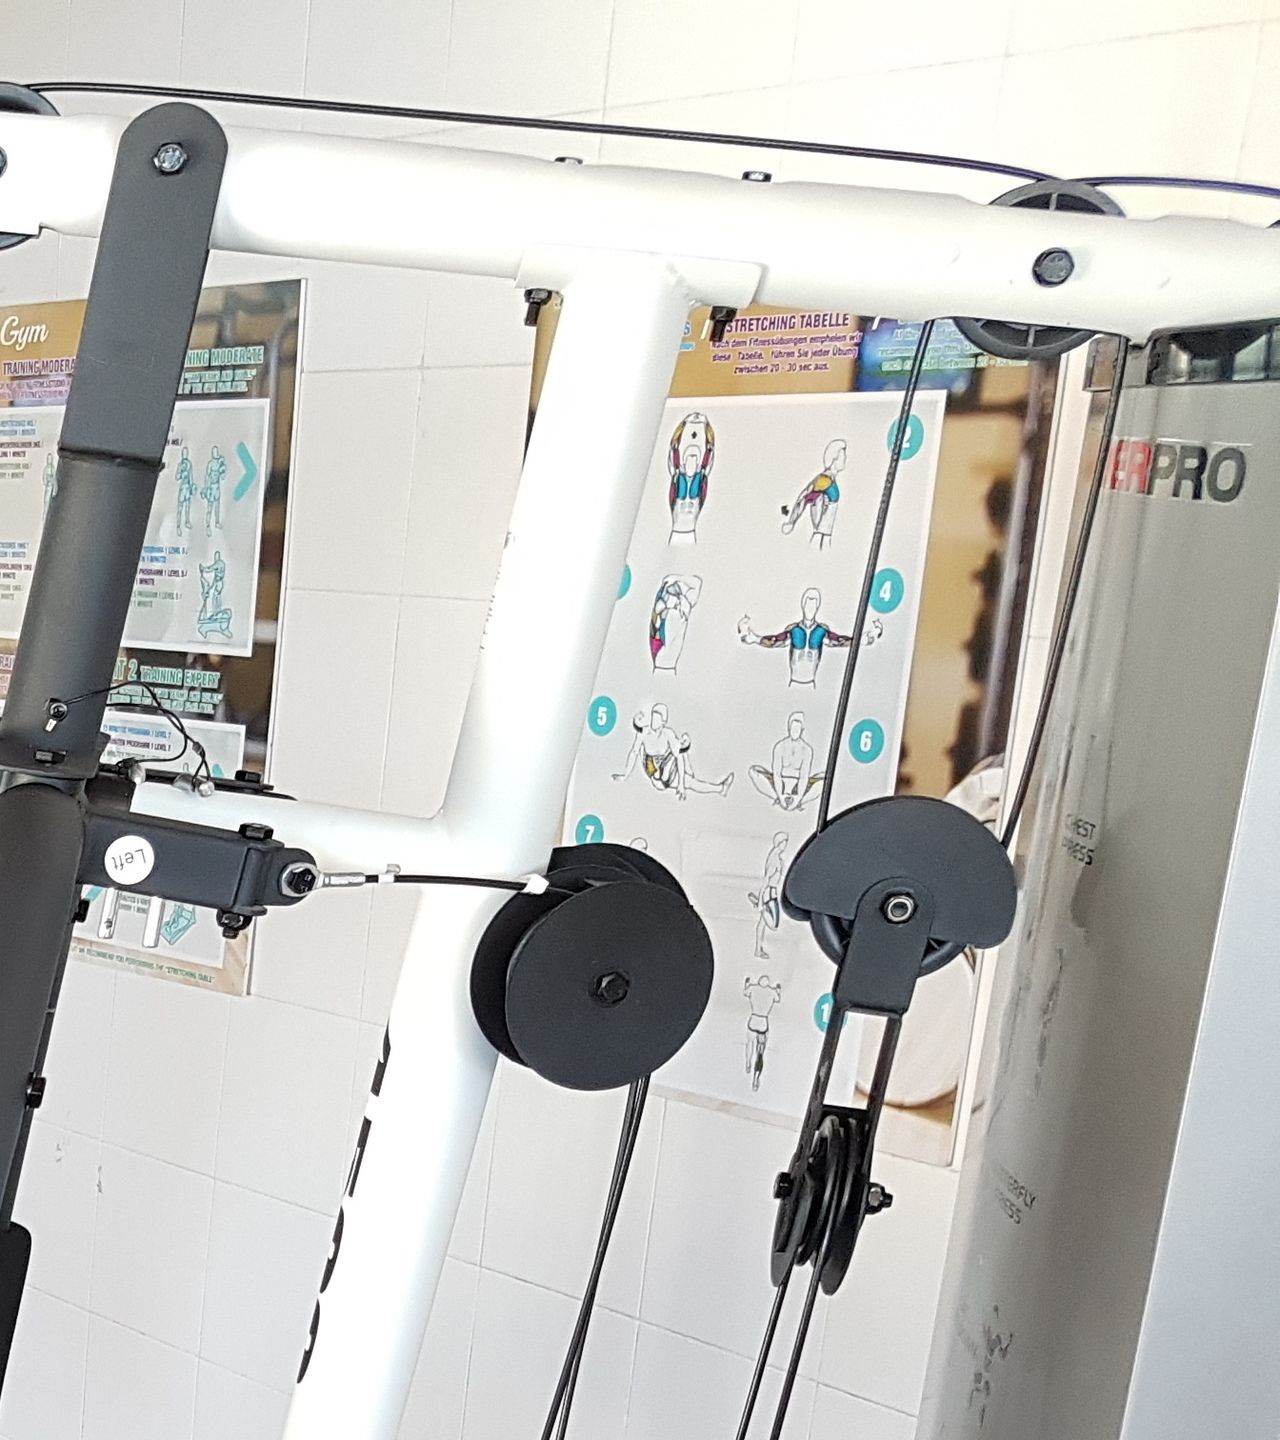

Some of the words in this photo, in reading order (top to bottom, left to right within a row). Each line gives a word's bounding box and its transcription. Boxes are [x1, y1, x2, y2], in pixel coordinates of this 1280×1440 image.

[0, 315, 48, 351] Gym
[726, 314, 796, 333] STRETCHING
[799, 312, 849, 330] TABELLE
[3, 360, 39, 376] TRAINING
[41, 358, 75, 373] MODERA
[787, 362, 796, 372] 30
[902, 425, 912, 448] 2
[879, 580, 892, 602] 4
[128, 659, 138, 680] 2
[140, 665, 182, 685] TRAINING
[184, 669, 221, 688] EXPERT
[597, 706, 608, 726] 5
[860, 730, 872, 752] 6
[585, 825, 595, 842] 7
[112, 848, 146, 870] Left
